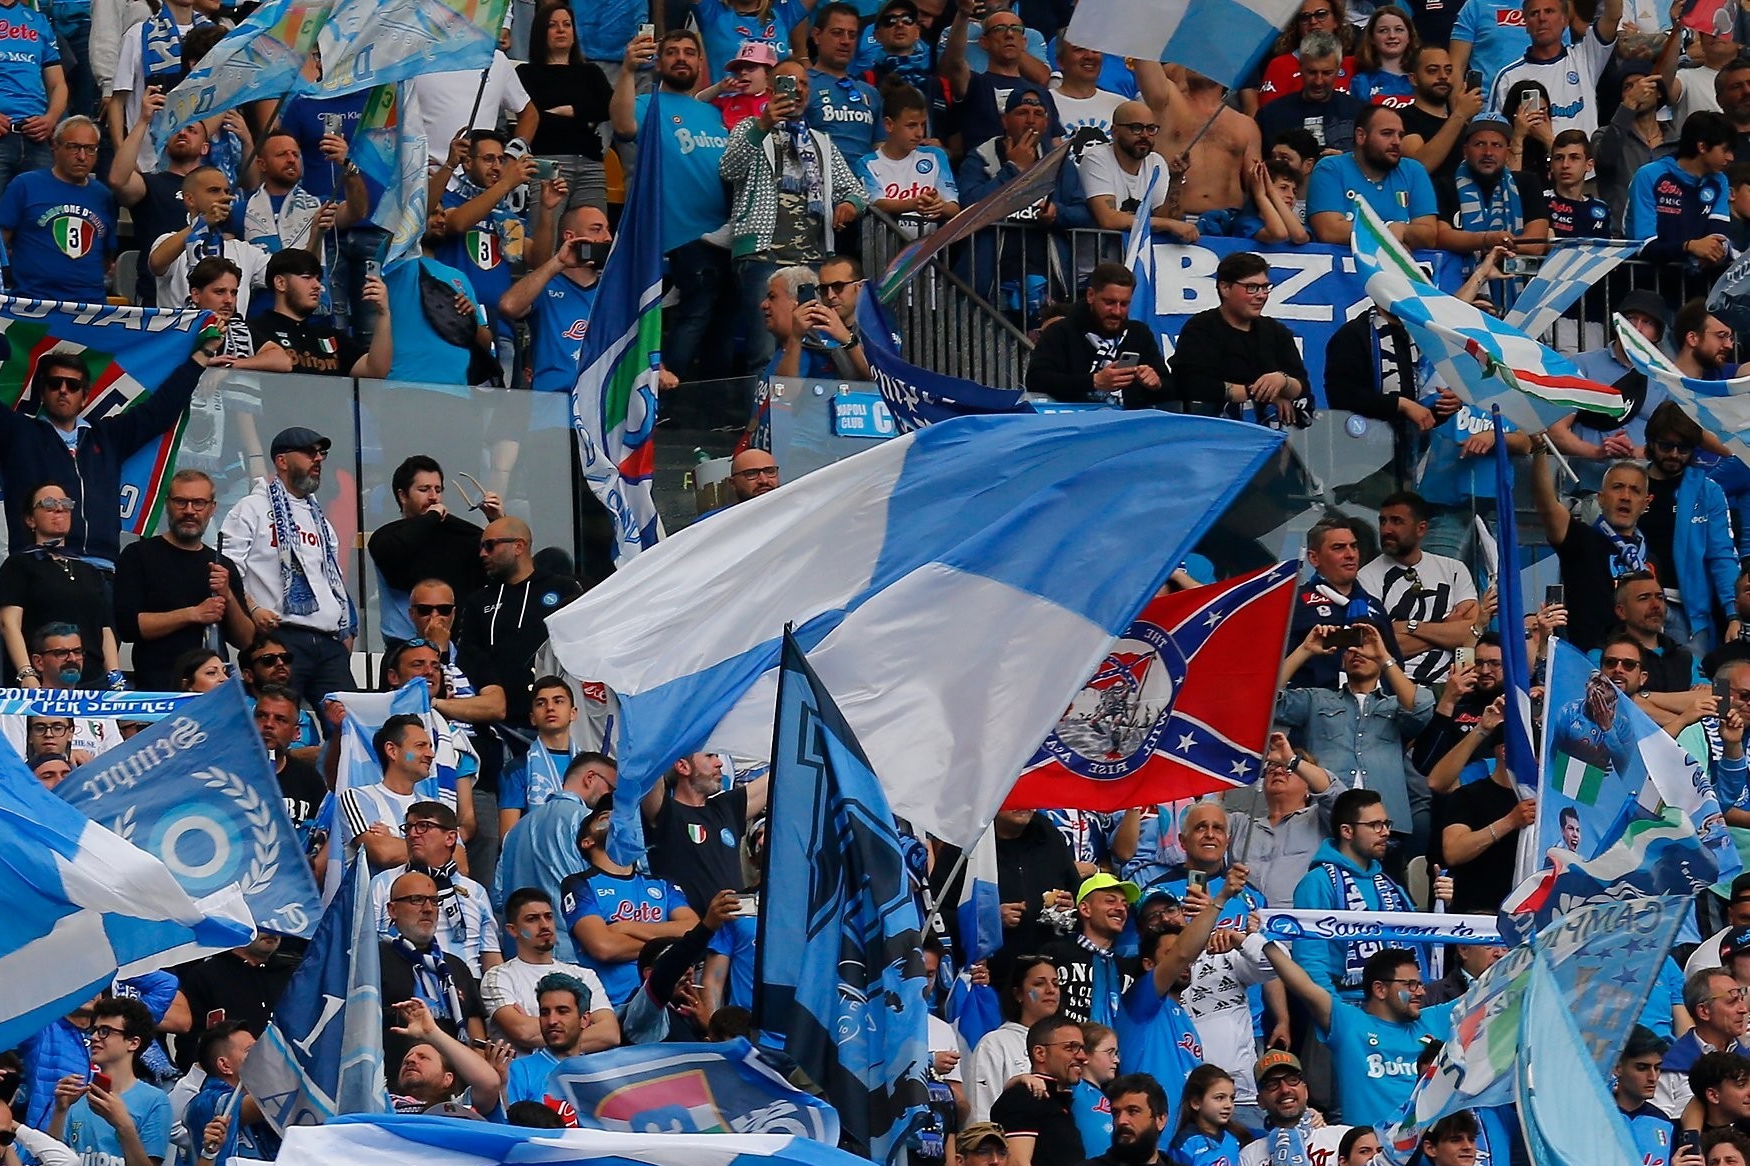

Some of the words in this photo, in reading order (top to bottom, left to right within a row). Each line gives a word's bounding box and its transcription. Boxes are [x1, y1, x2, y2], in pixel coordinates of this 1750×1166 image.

[70, 226, 86, 254] 3
[479, 240, 491, 262] 3
[838, 416, 863, 432] CLUB
[41, 697, 83, 715] PER
[610, 899, 661, 924] Lete
